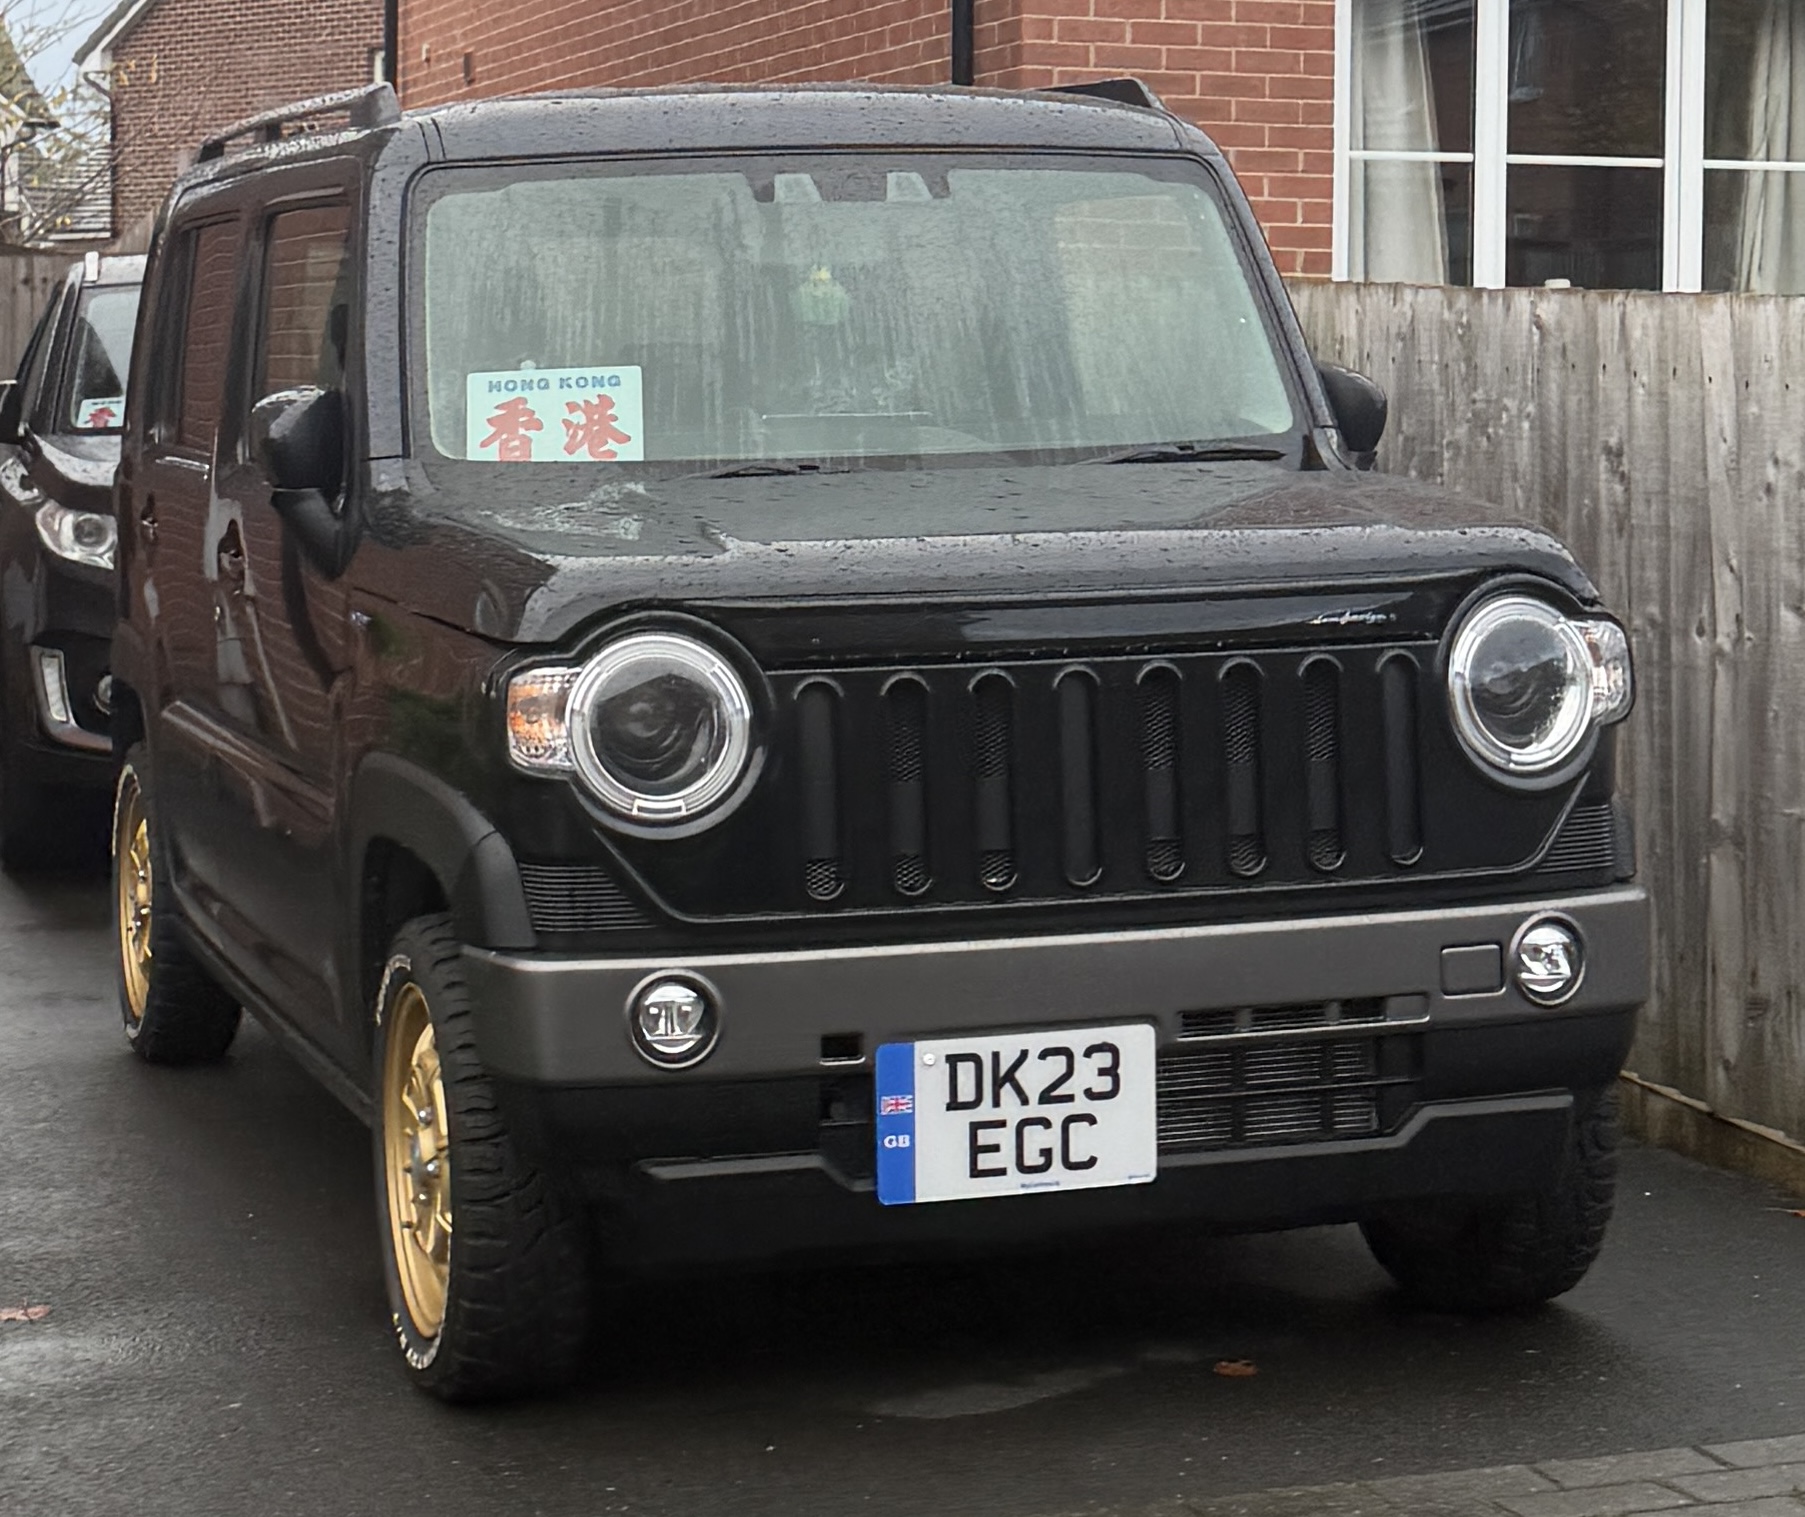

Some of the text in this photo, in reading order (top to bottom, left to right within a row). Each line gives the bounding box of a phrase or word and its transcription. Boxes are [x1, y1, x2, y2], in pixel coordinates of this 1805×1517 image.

[488, 375, 621, 392] HONG KONG
[479, 394, 631, 461] 香港
[945, 1042, 1120, 1111] DK23
[883, 1135, 910, 1148] GB
[969, 1113, 1098, 1178] EGC
